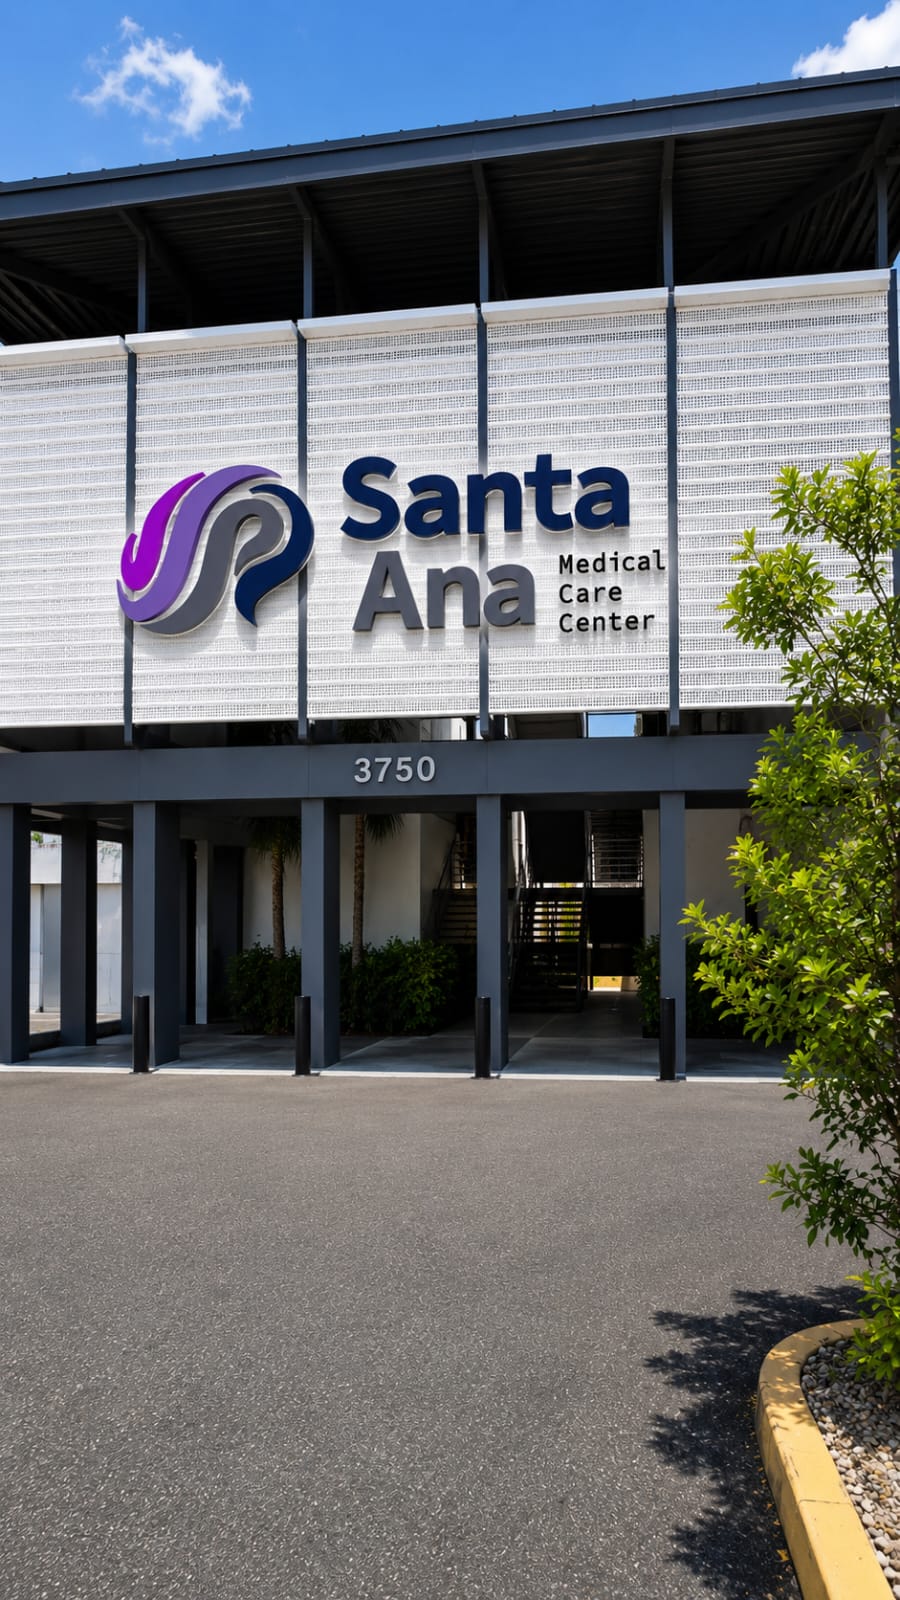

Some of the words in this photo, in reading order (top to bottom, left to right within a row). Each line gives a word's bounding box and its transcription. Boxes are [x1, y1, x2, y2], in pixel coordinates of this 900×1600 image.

[340, 454, 630, 542] Santa
[559, 549, 666, 575] Medical
[352, 550, 536, 632] Ana
[559, 584, 623, 604] Care
[559, 611, 656, 633] Center
[354, 755, 436, 783] 3750
